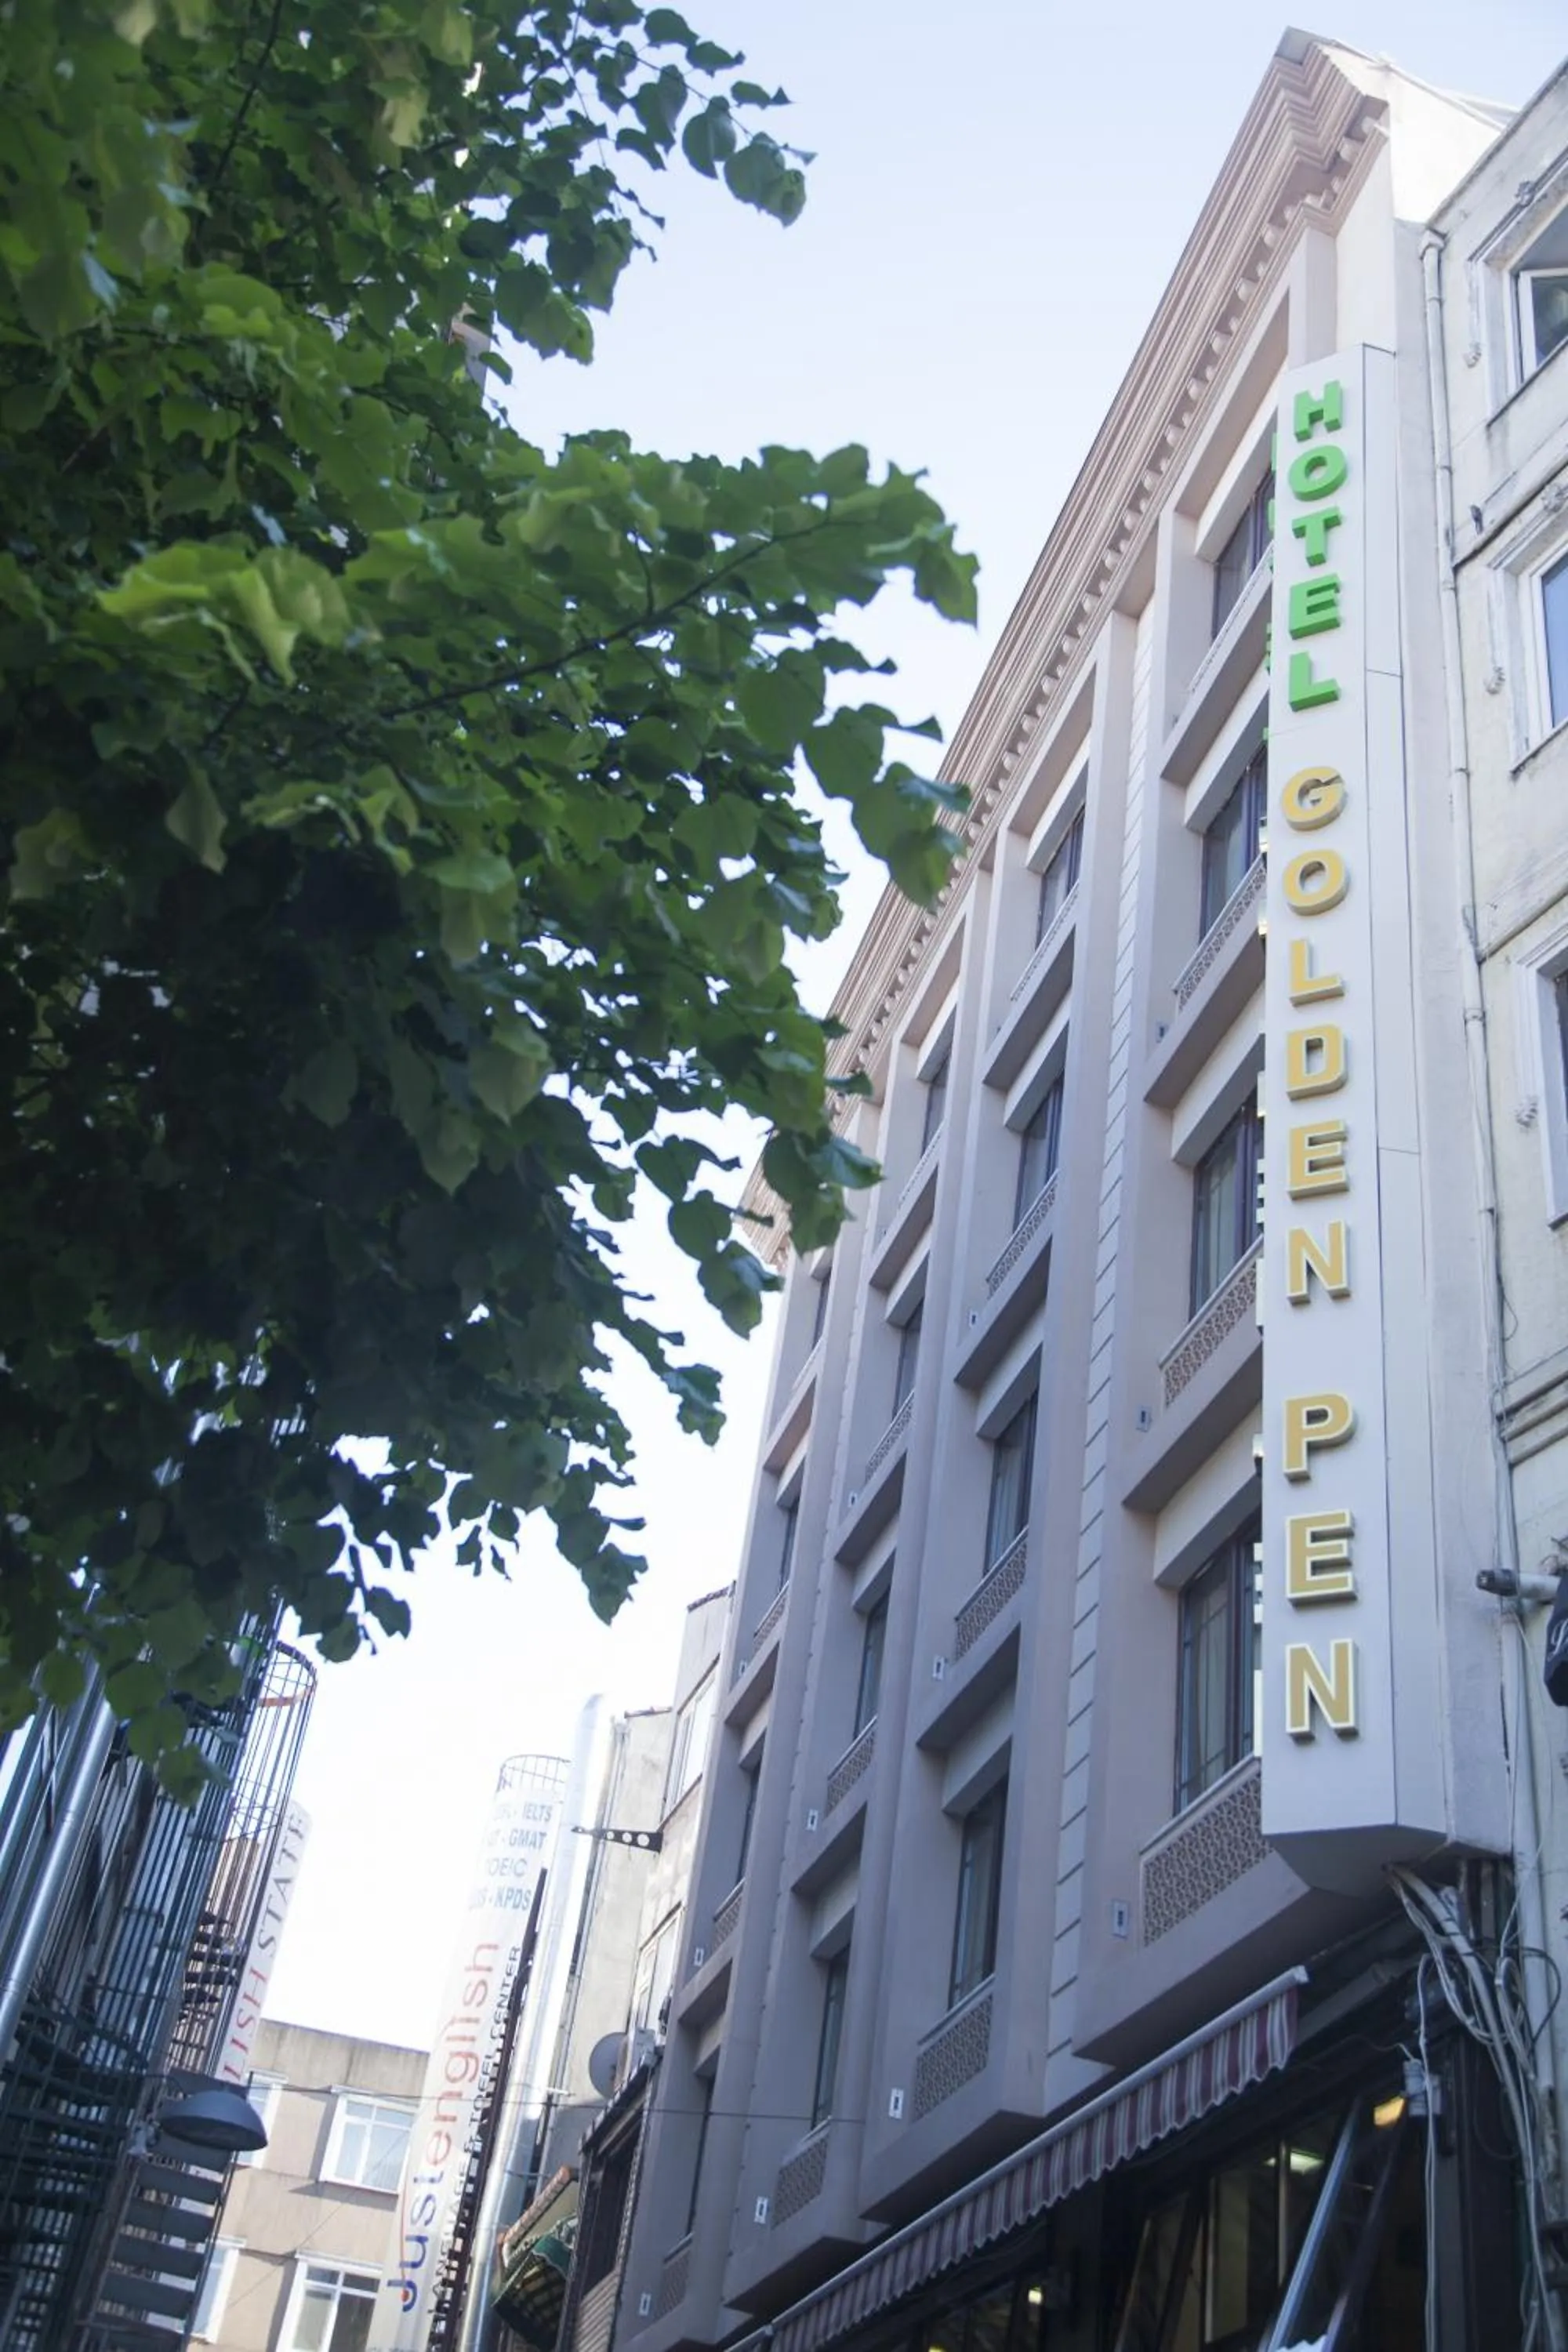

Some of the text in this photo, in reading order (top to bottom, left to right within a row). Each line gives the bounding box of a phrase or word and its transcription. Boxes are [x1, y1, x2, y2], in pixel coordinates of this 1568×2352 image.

[1281, 379, 1359, 1740] HOTEL GOLDEN PEN
[508, 1828, 547, 1850] GMAT
[522, 1802, 553, 1824] IELTS
[256, 1810, 306, 1957] STATE
[490, 1945, 521, 2039] CENTER
